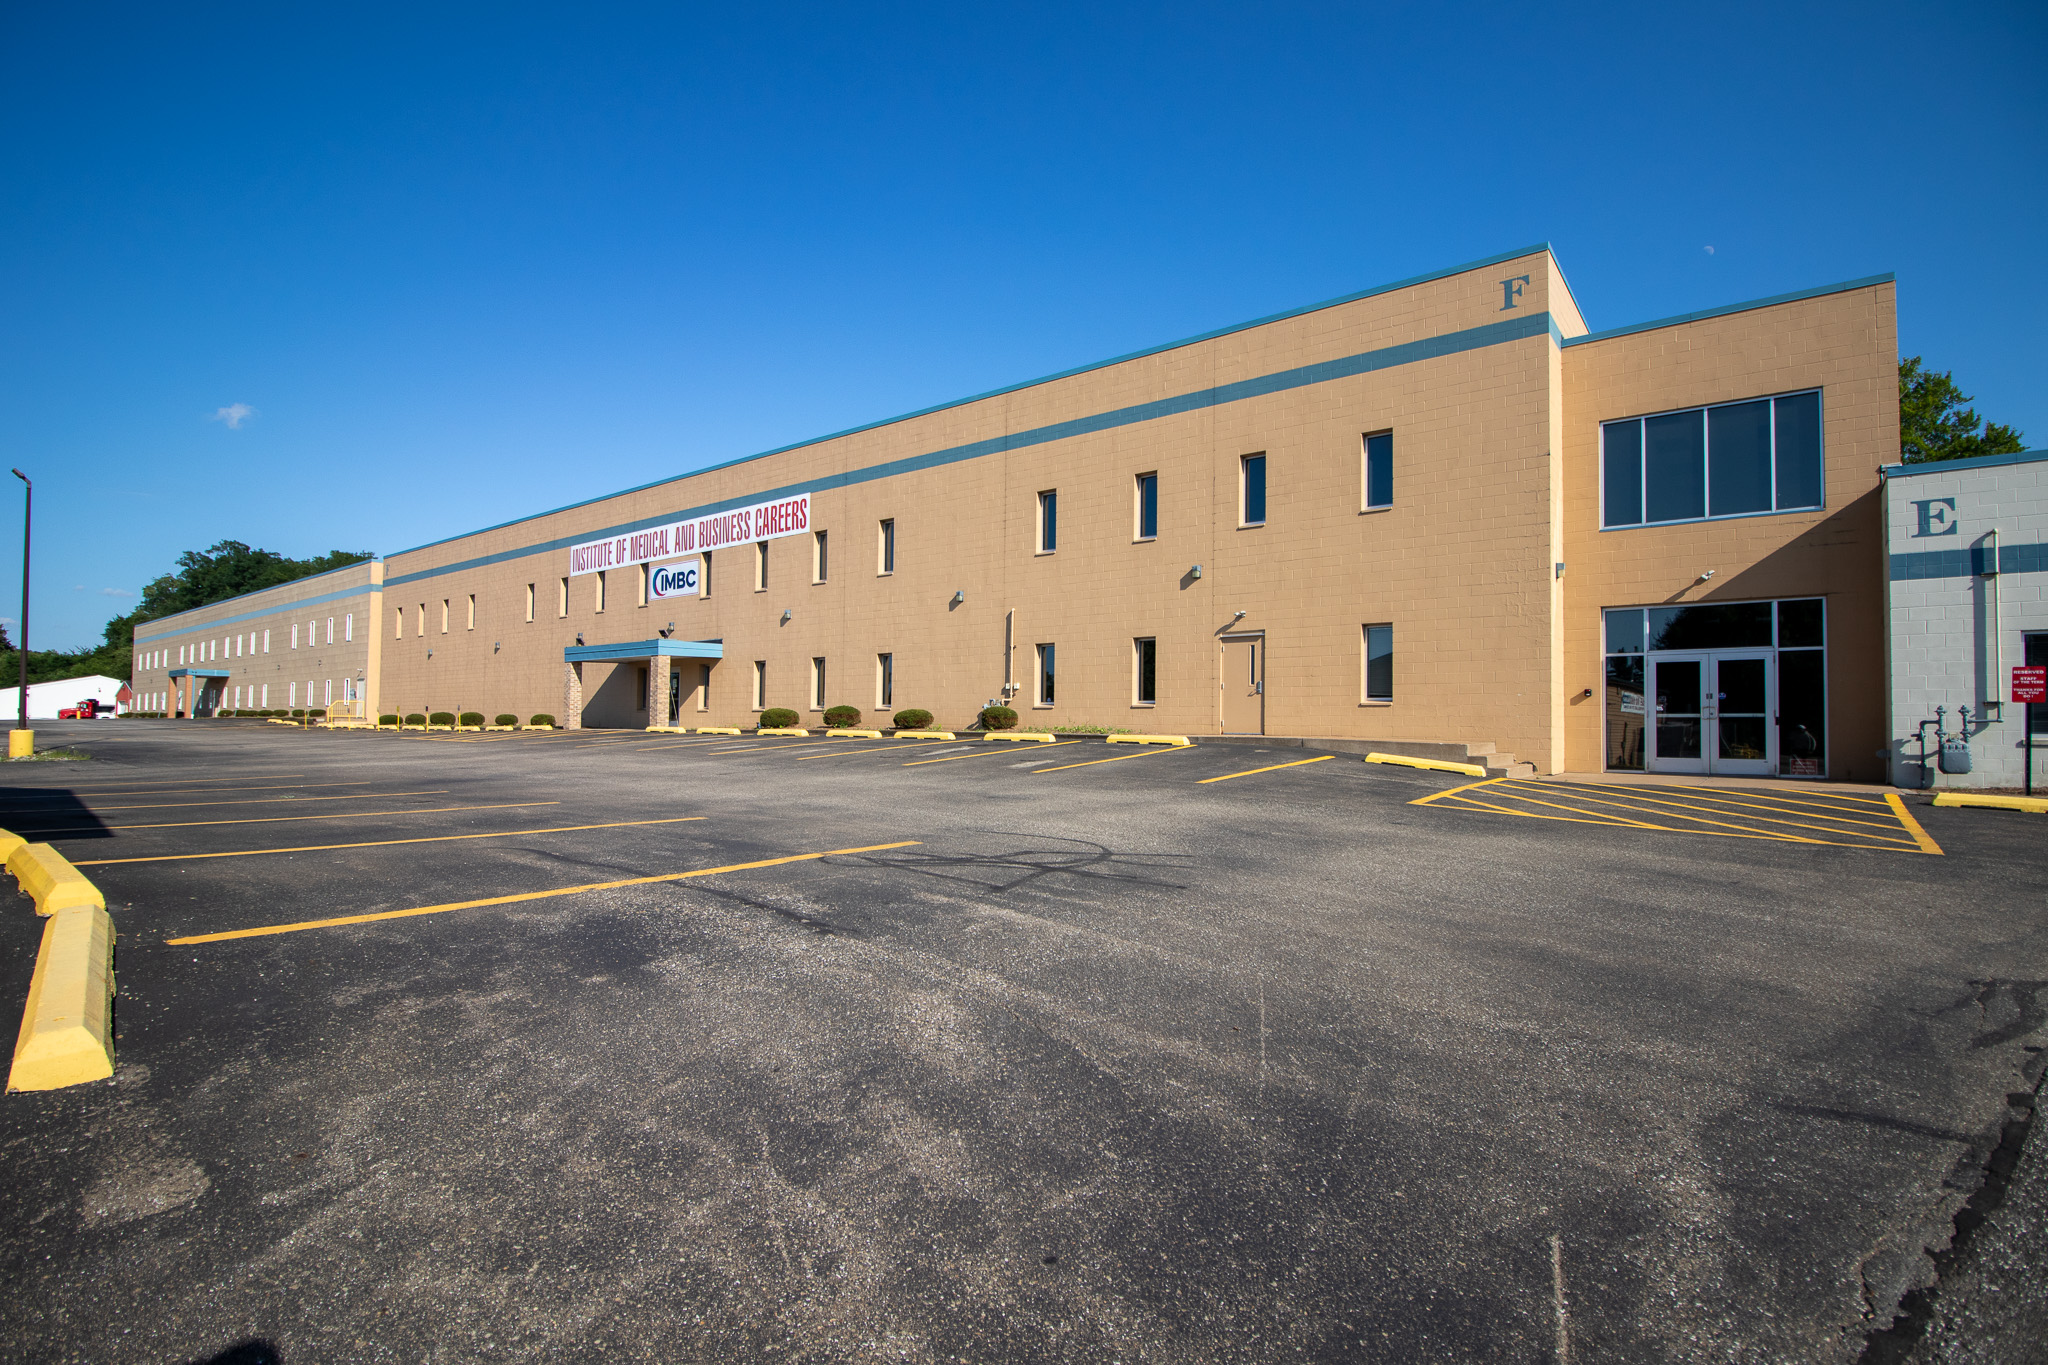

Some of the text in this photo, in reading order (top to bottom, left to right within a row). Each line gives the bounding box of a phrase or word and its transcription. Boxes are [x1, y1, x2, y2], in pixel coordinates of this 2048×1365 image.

[1499, 274, 1530, 311] F
[572, 498, 807, 573] INSTITUTE OF MEDICAL AND BUSINESS CAREERS
[1910, 497, 1958, 538] E
[661, 569, 696, 591] IMBC
